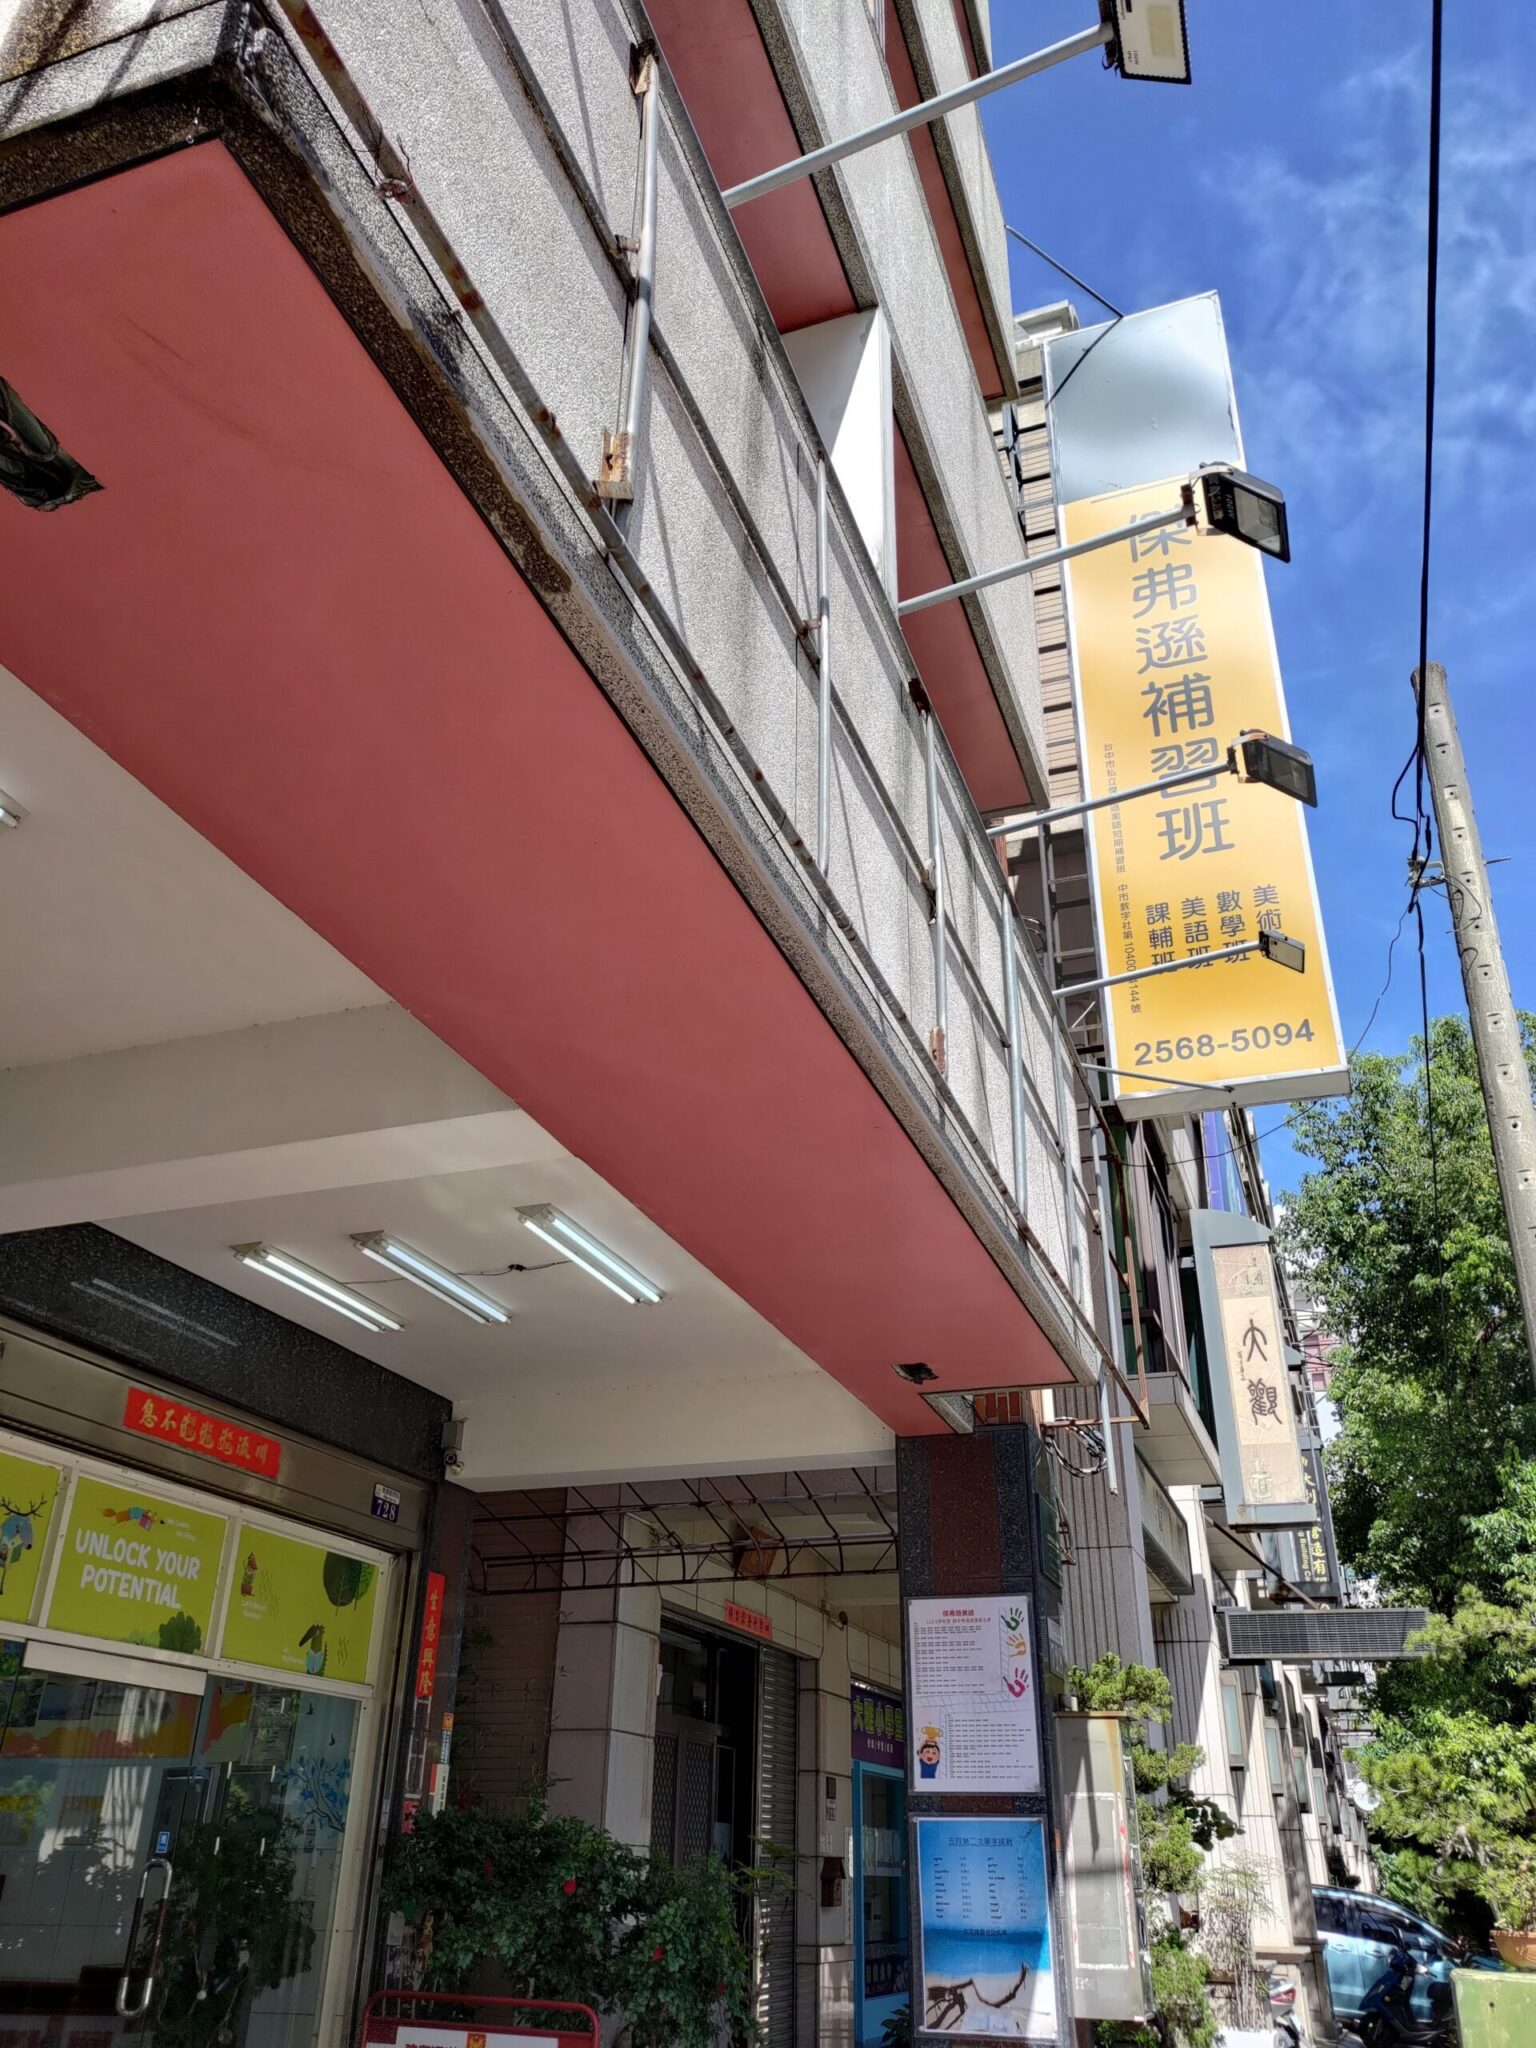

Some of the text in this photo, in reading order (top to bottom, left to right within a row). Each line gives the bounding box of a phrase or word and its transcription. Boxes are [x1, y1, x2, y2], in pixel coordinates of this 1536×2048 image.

[1181, 895, 1214, 969] 美語班
[1215, 889, 1250, 963] 數學班
[1133, 1018, 1316, 1067] 2568-5094
[376, 1499, 396, 1521] 728
[75, 1527, 201, 1580] UNLOCK YOUR
[80, 1563, 182, 1609] POTENTIAL
